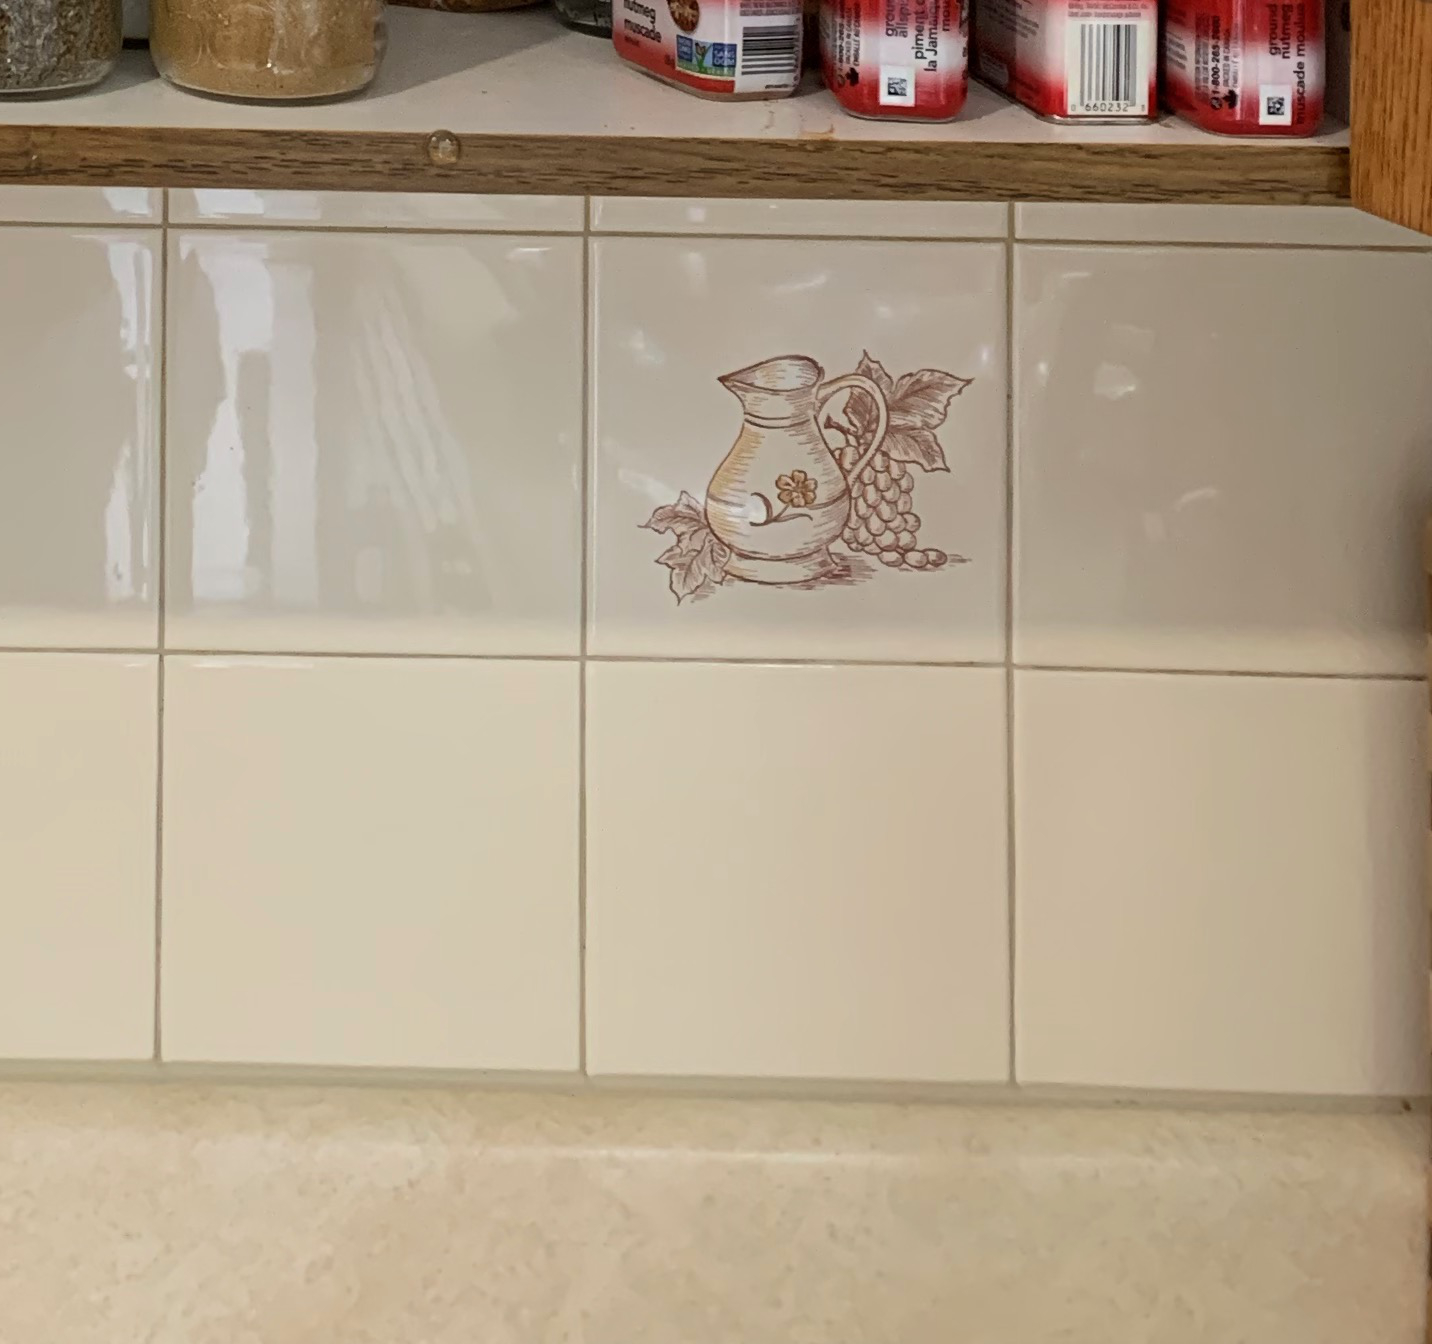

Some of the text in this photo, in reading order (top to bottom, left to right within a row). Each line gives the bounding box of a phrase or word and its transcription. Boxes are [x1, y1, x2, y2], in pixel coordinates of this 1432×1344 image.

[624, 19, 662, 44] muscade
[911, 9, 928, 60] piment
[1267, 3, 1282, 56] ground
[1279, 3, 1293, 59] nutmeg
[924, 60, 938, 72] la
[1292, 62, 1306, 125] muscade
